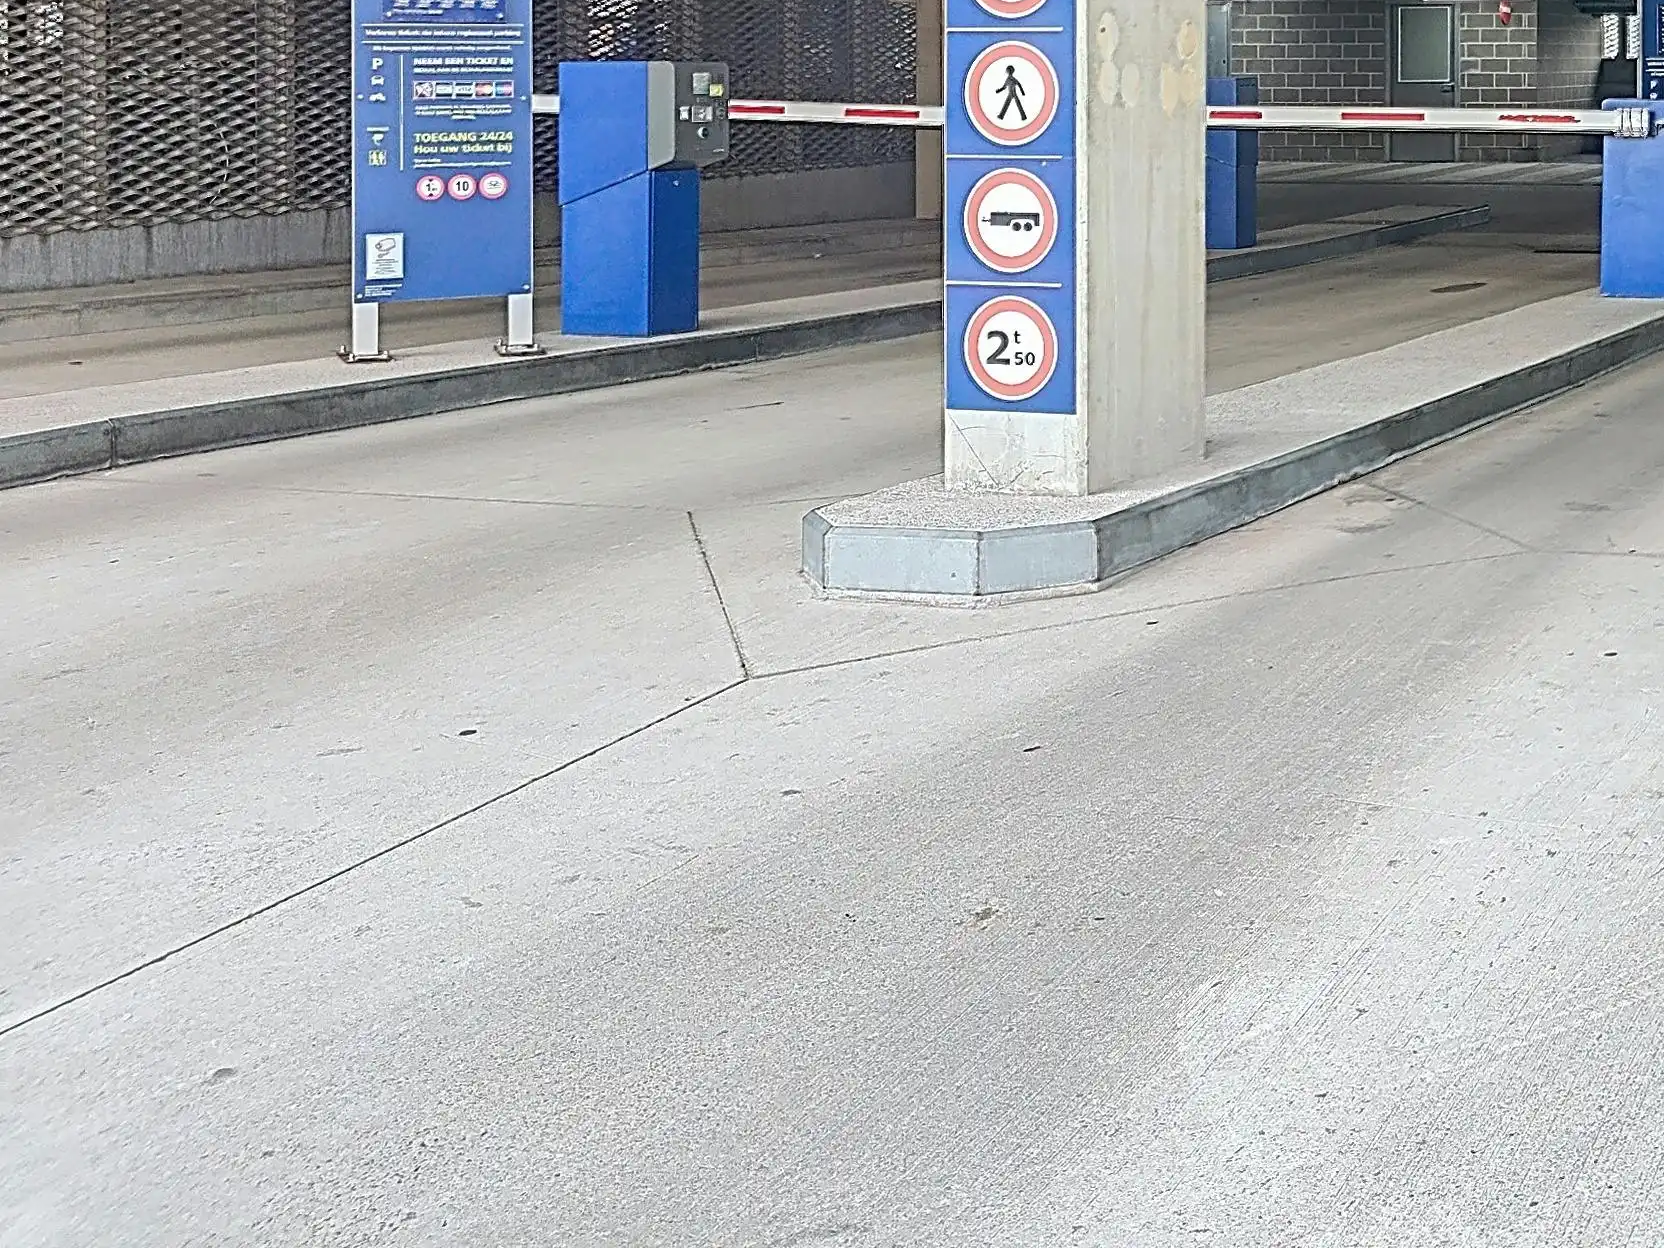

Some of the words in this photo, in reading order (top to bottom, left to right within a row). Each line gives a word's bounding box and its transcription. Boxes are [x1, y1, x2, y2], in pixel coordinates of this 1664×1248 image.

[413, 132, 477, 143] TOEGANG
[480, 131, 514, 141] 24/24
[455, 181, 470, 192] 10
